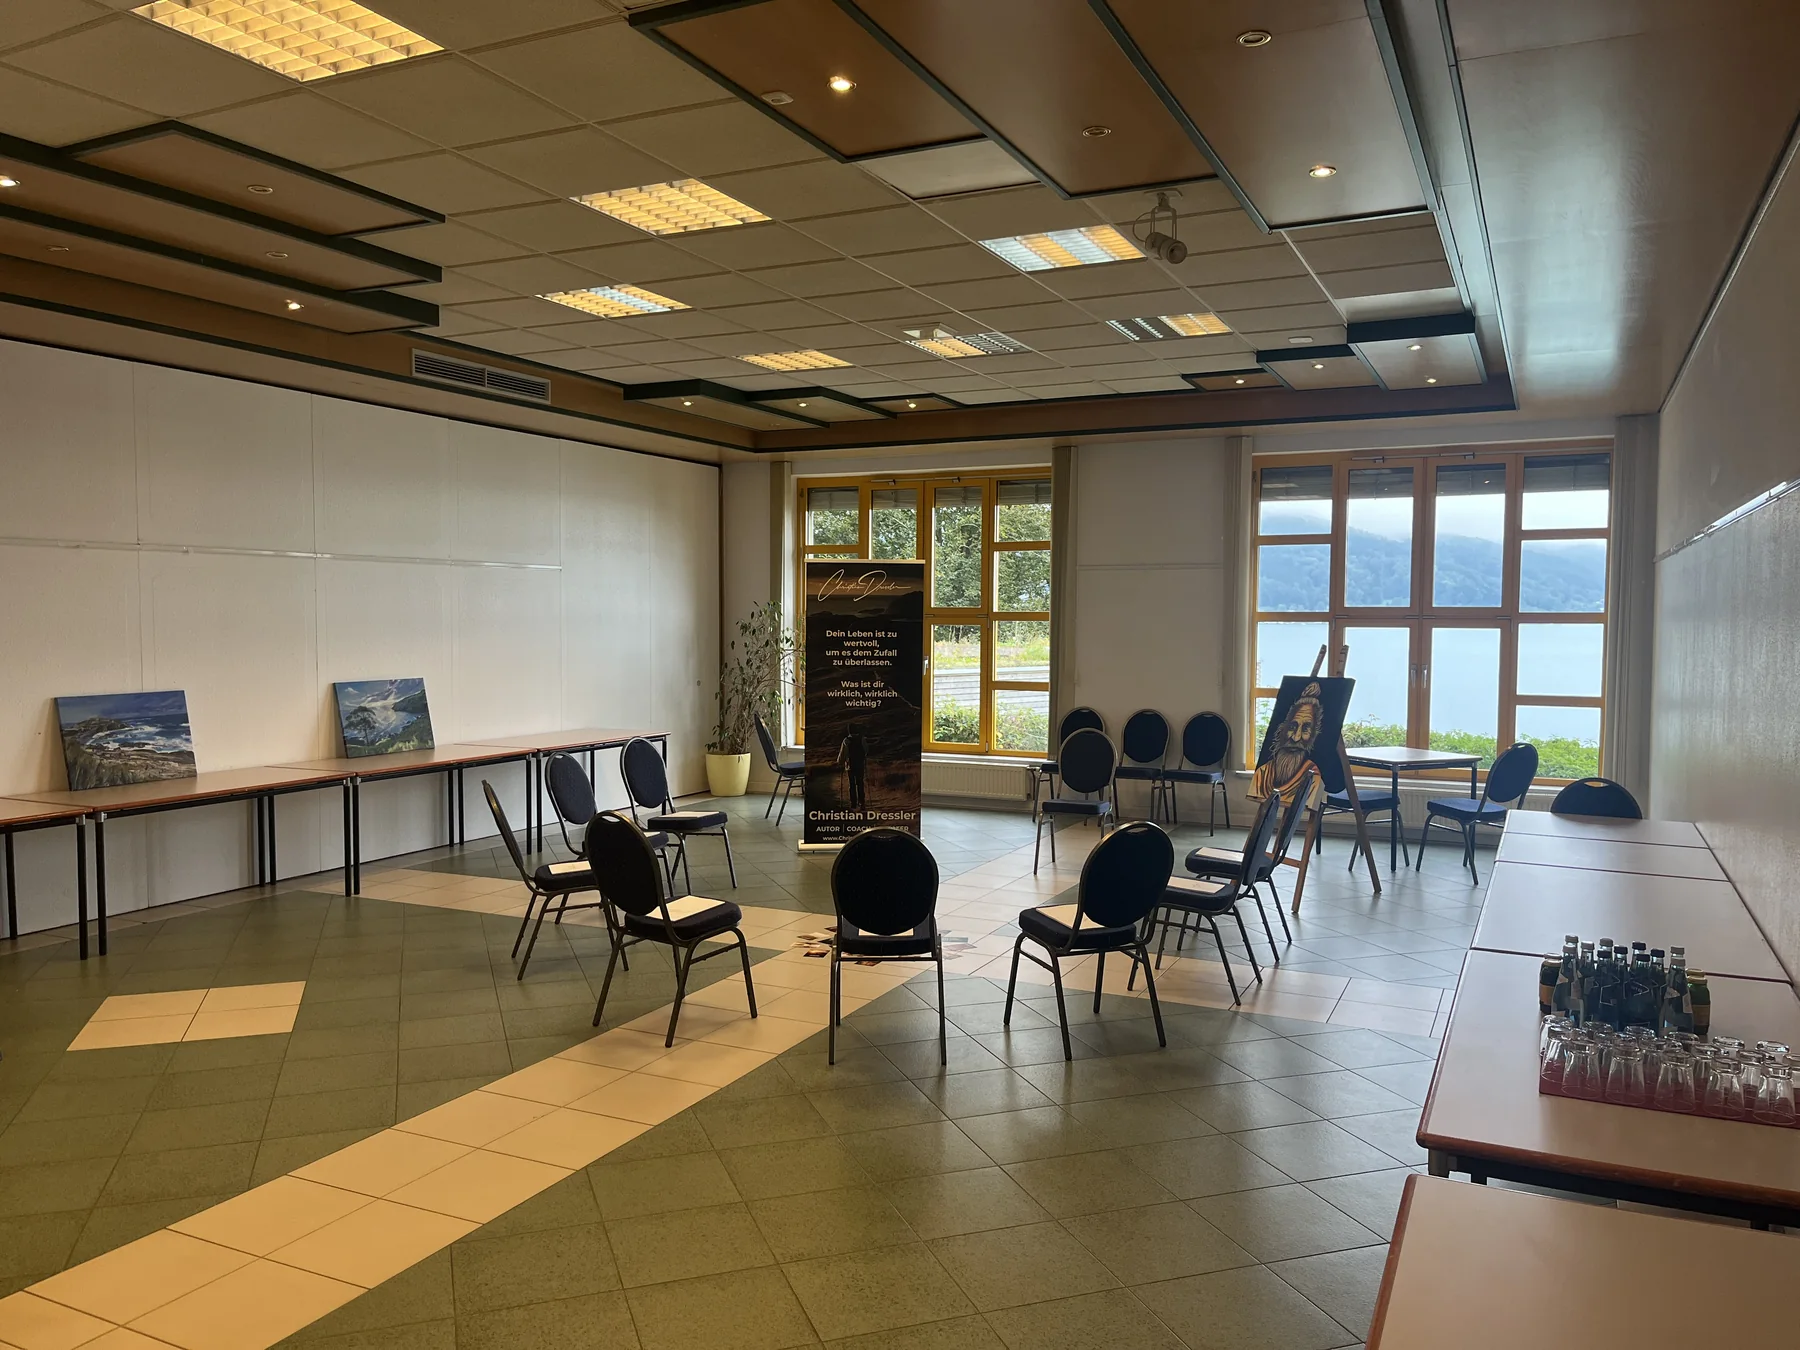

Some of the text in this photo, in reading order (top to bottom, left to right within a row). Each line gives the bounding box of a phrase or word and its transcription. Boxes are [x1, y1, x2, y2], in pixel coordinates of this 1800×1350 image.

[826, 630, 846, 638] Dein
[847, 630, 874, 638] Leben
[875, 630, 886, 638] ist
[843, 640, 880, 648] wertvoll,
[852, 649, 872, 657] dem
[873, 649, 898, 657] Zufall
[844, 658, 893, 666] überlassen.
[860, 680, 871, 688] ist
[872, 680, 885, 688] dir
[827, 689, 898, 699] wirklich, wirklich
[845, 699, 882, 709] wichtig?
[808, 810, 916, 820] Christian Dressler
